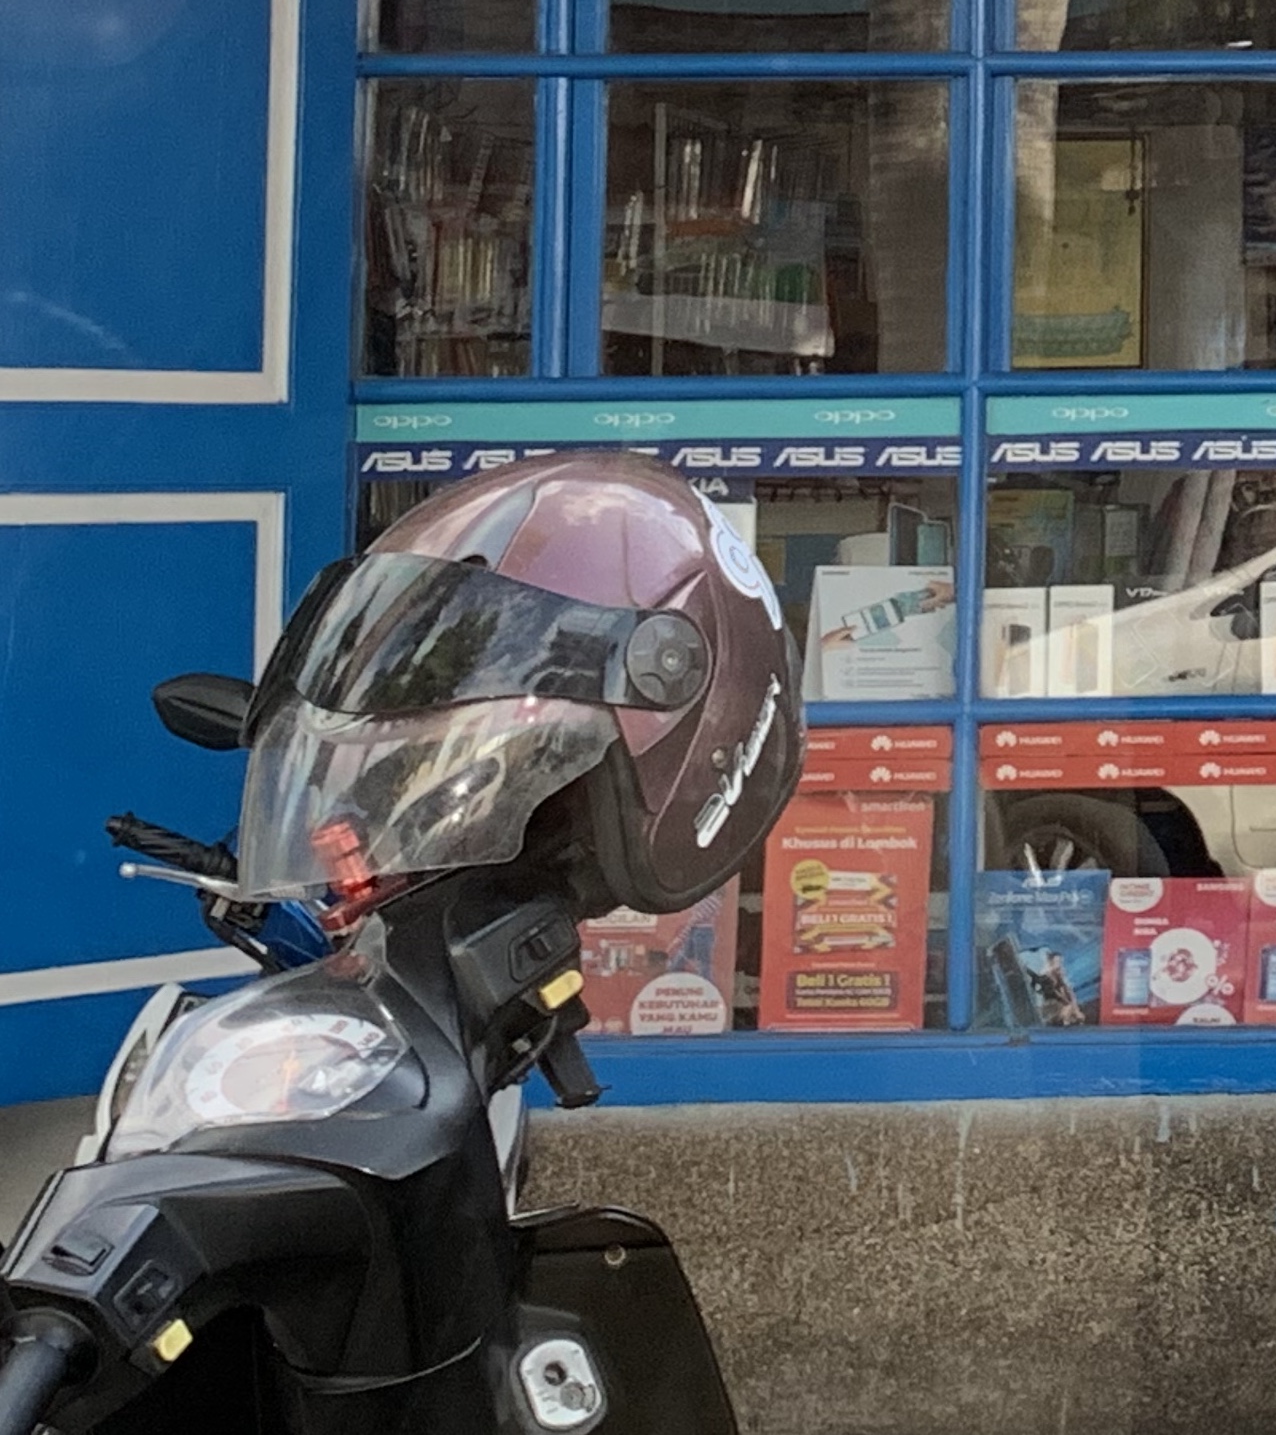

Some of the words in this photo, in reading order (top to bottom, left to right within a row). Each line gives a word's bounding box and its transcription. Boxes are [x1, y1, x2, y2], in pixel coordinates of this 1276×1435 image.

[361, 450, 453, 472] ASUS
[671, 446, 762, 468] ASUS
[773, 446, 865, 468] ASUS
[876, 446, 963, 467] ASUS
[991, 441, 1080, 463] ASUS
[1090, 441, 1181, 462] ASUS
